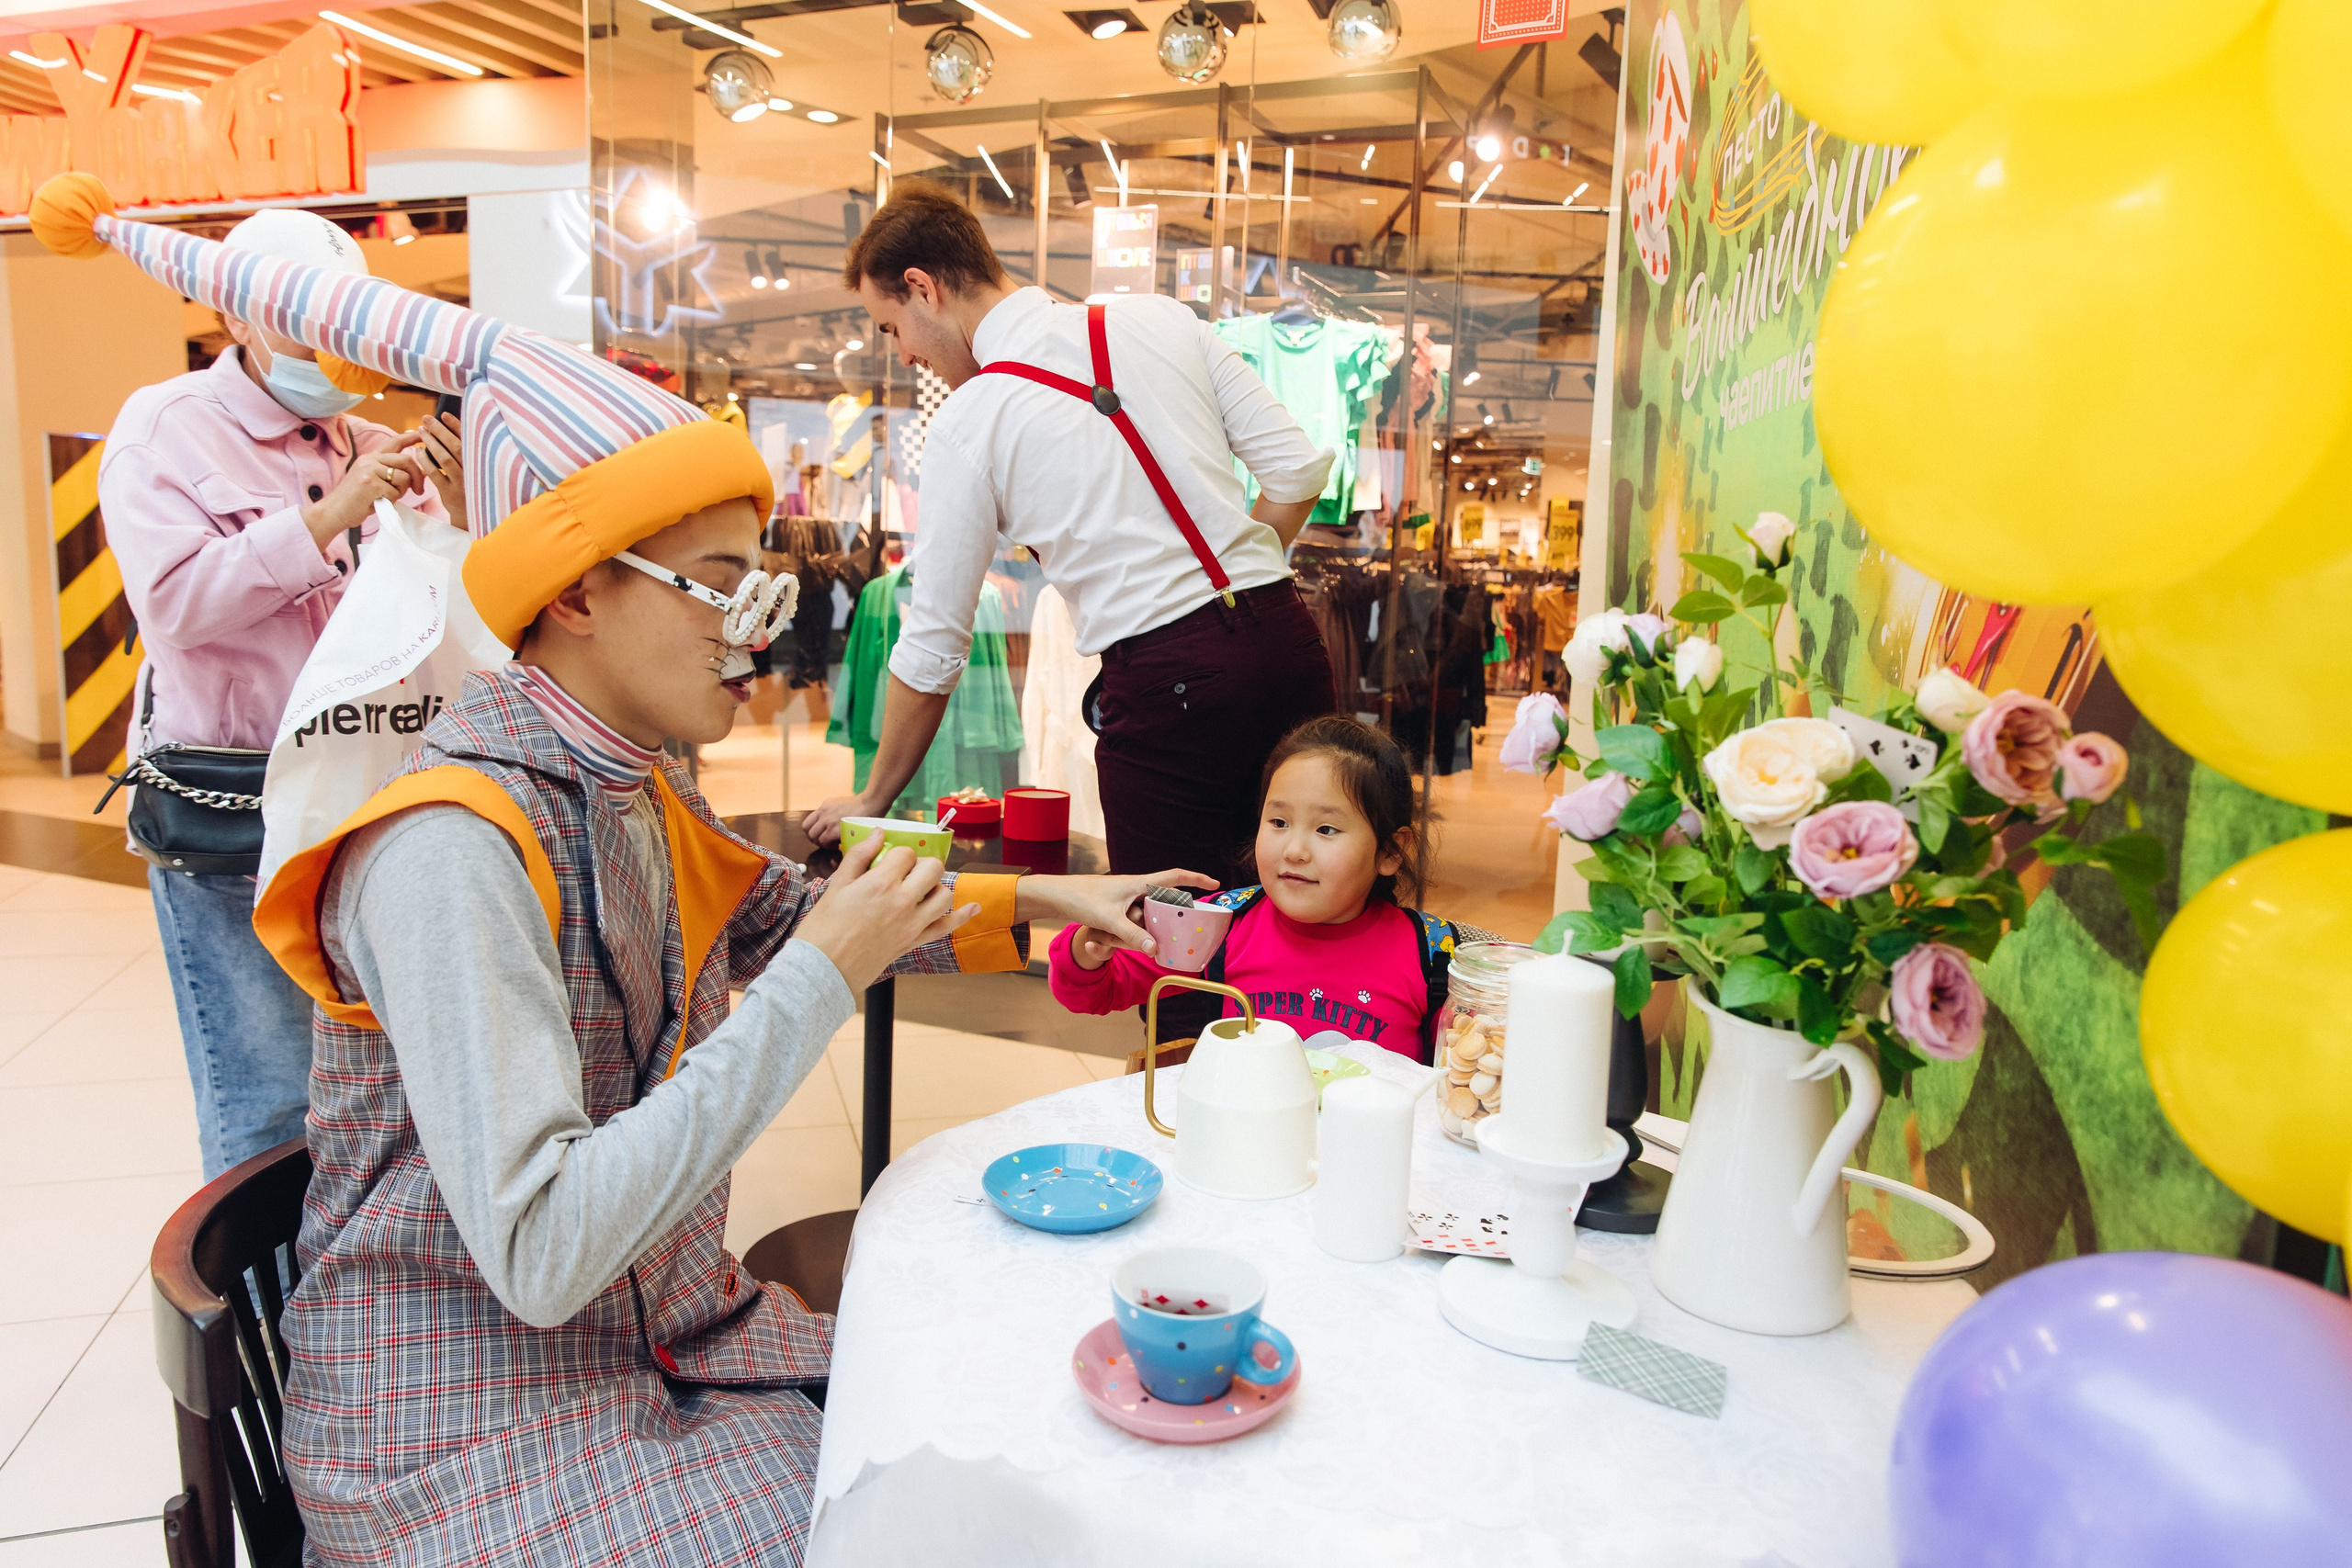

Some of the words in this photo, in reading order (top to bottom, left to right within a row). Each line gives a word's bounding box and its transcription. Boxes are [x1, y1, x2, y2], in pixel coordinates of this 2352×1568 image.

[1722, 91, 1781, 190] ПЕСТО
[1720, 341, 1815, 432] чаепитие
[282, 683, 338, 727] БОЛЬШЕ
[334, 655, 401, 689] ТОВАРОВ
[401, 643, 420, 660] НА
[1311, 997, 1388, 1042] KITTY
